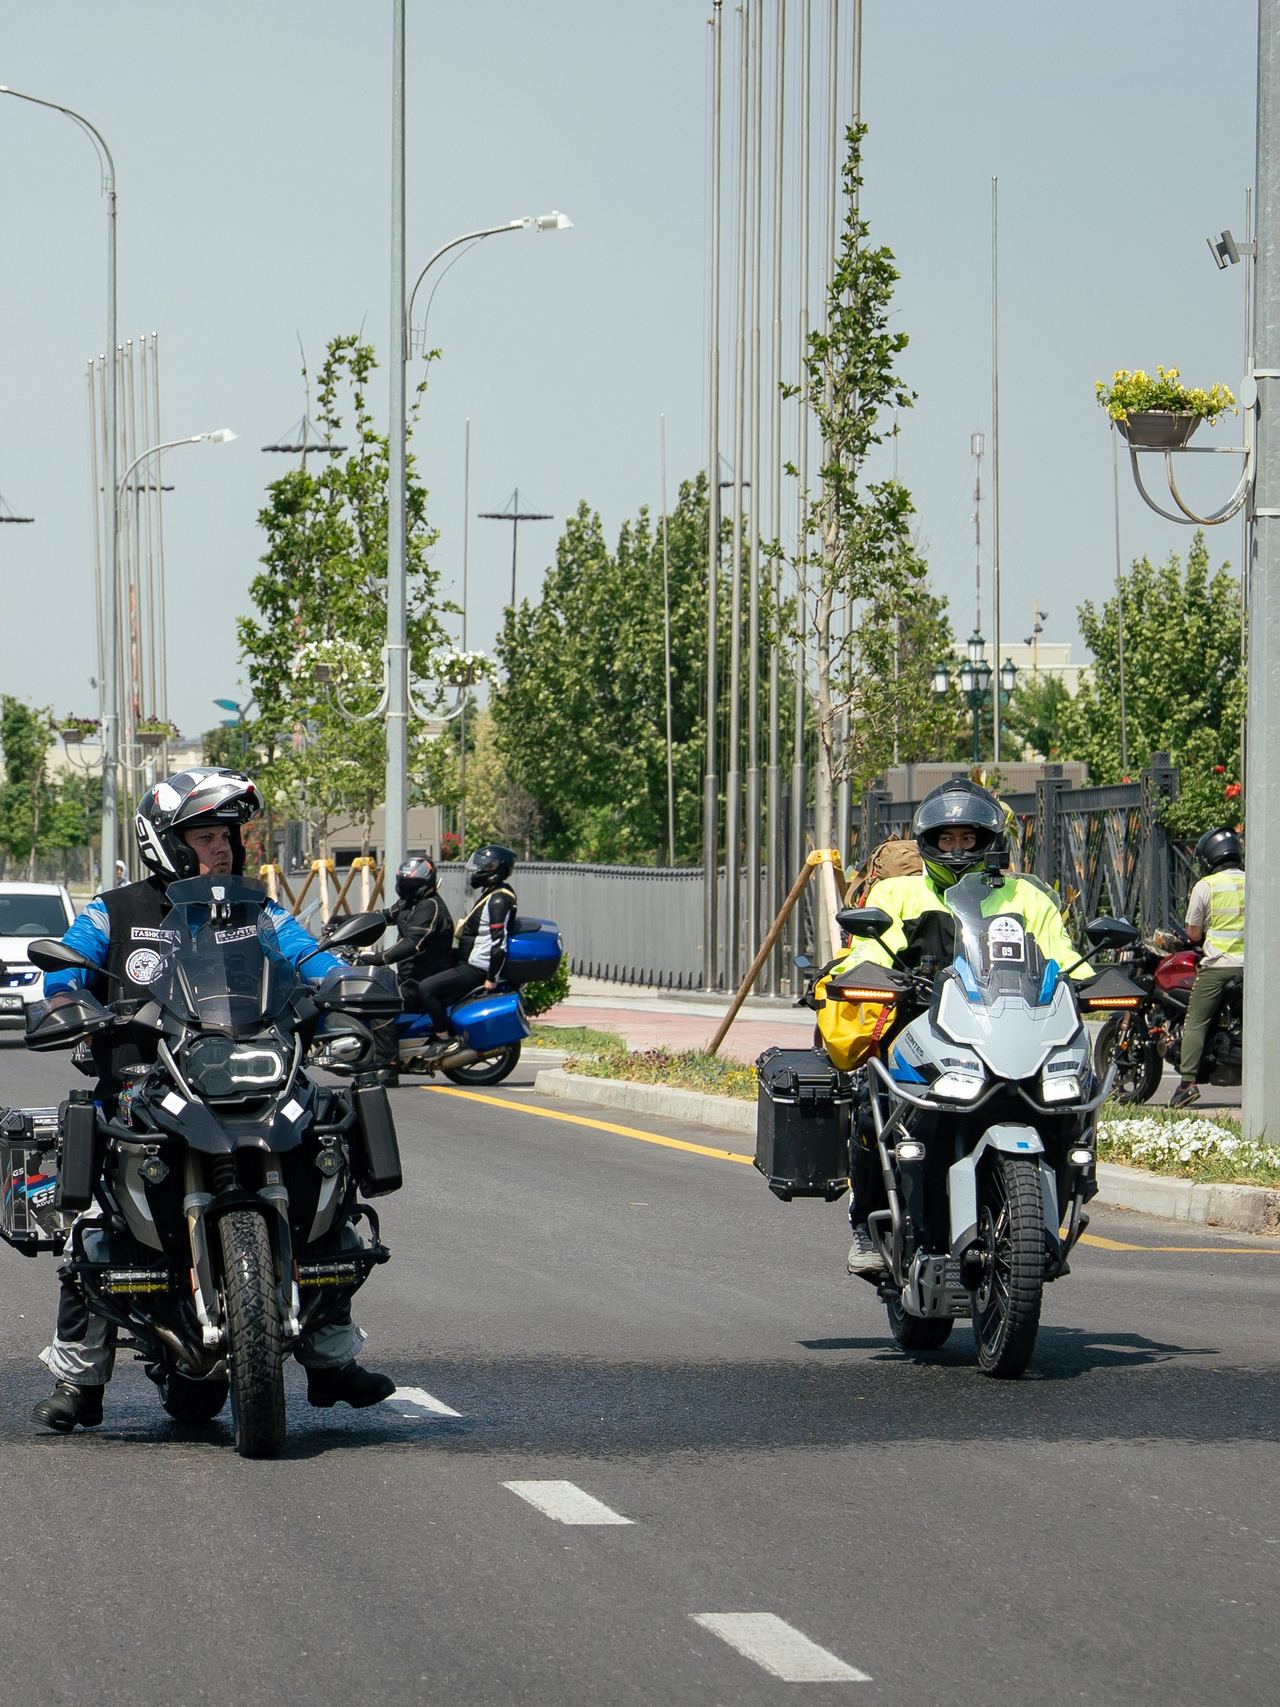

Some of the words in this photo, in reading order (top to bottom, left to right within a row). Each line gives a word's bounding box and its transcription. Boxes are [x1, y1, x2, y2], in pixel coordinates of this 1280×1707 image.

[1002, 946, 1013, 957] 09
[905, 1030, 925, 1058] ZONTES
[13, 1167, 24, 1177] GS
